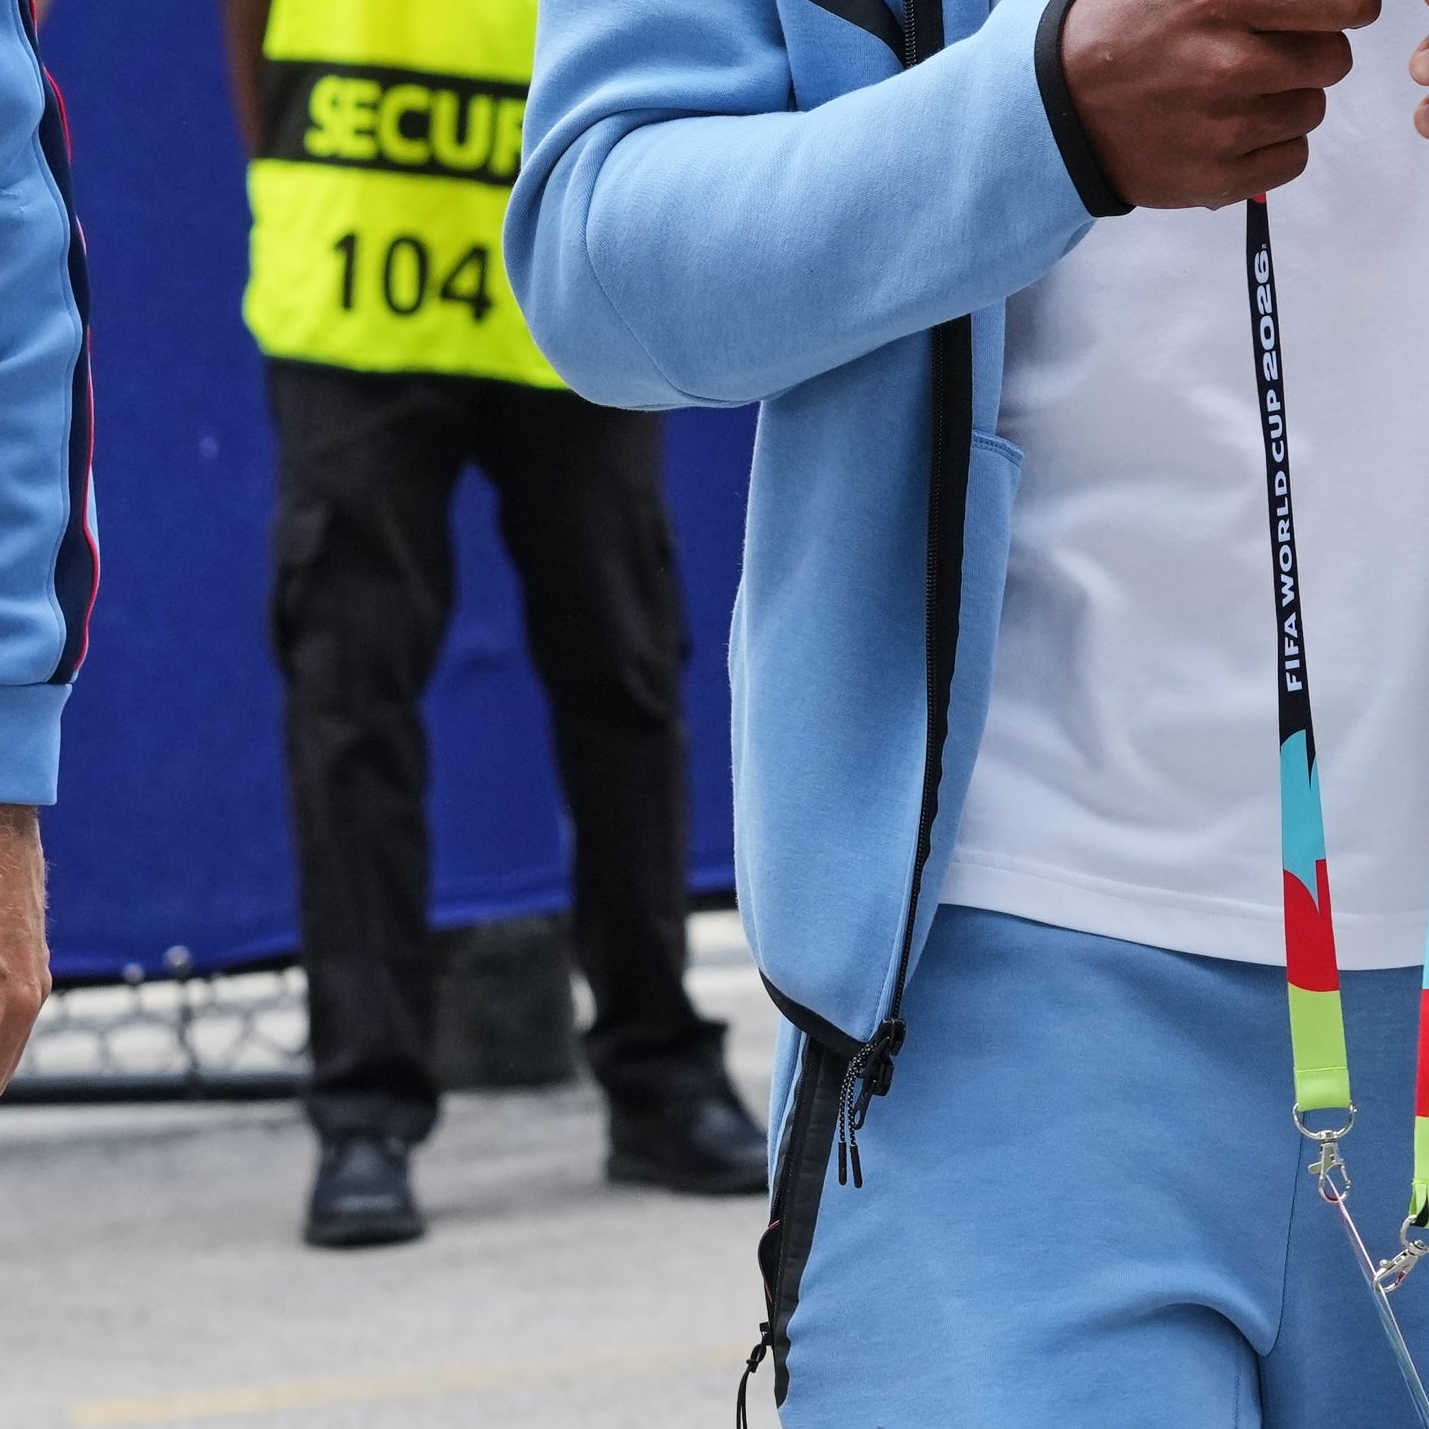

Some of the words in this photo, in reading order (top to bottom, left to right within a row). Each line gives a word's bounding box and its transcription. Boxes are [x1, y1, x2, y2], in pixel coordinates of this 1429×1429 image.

[333, 231, 493, 324] 104
[1266, 389, 1285, 463] CUP
[1274, 470, 1295, 607] WORLD
[1284, 611, 1303, 692] FIFA
